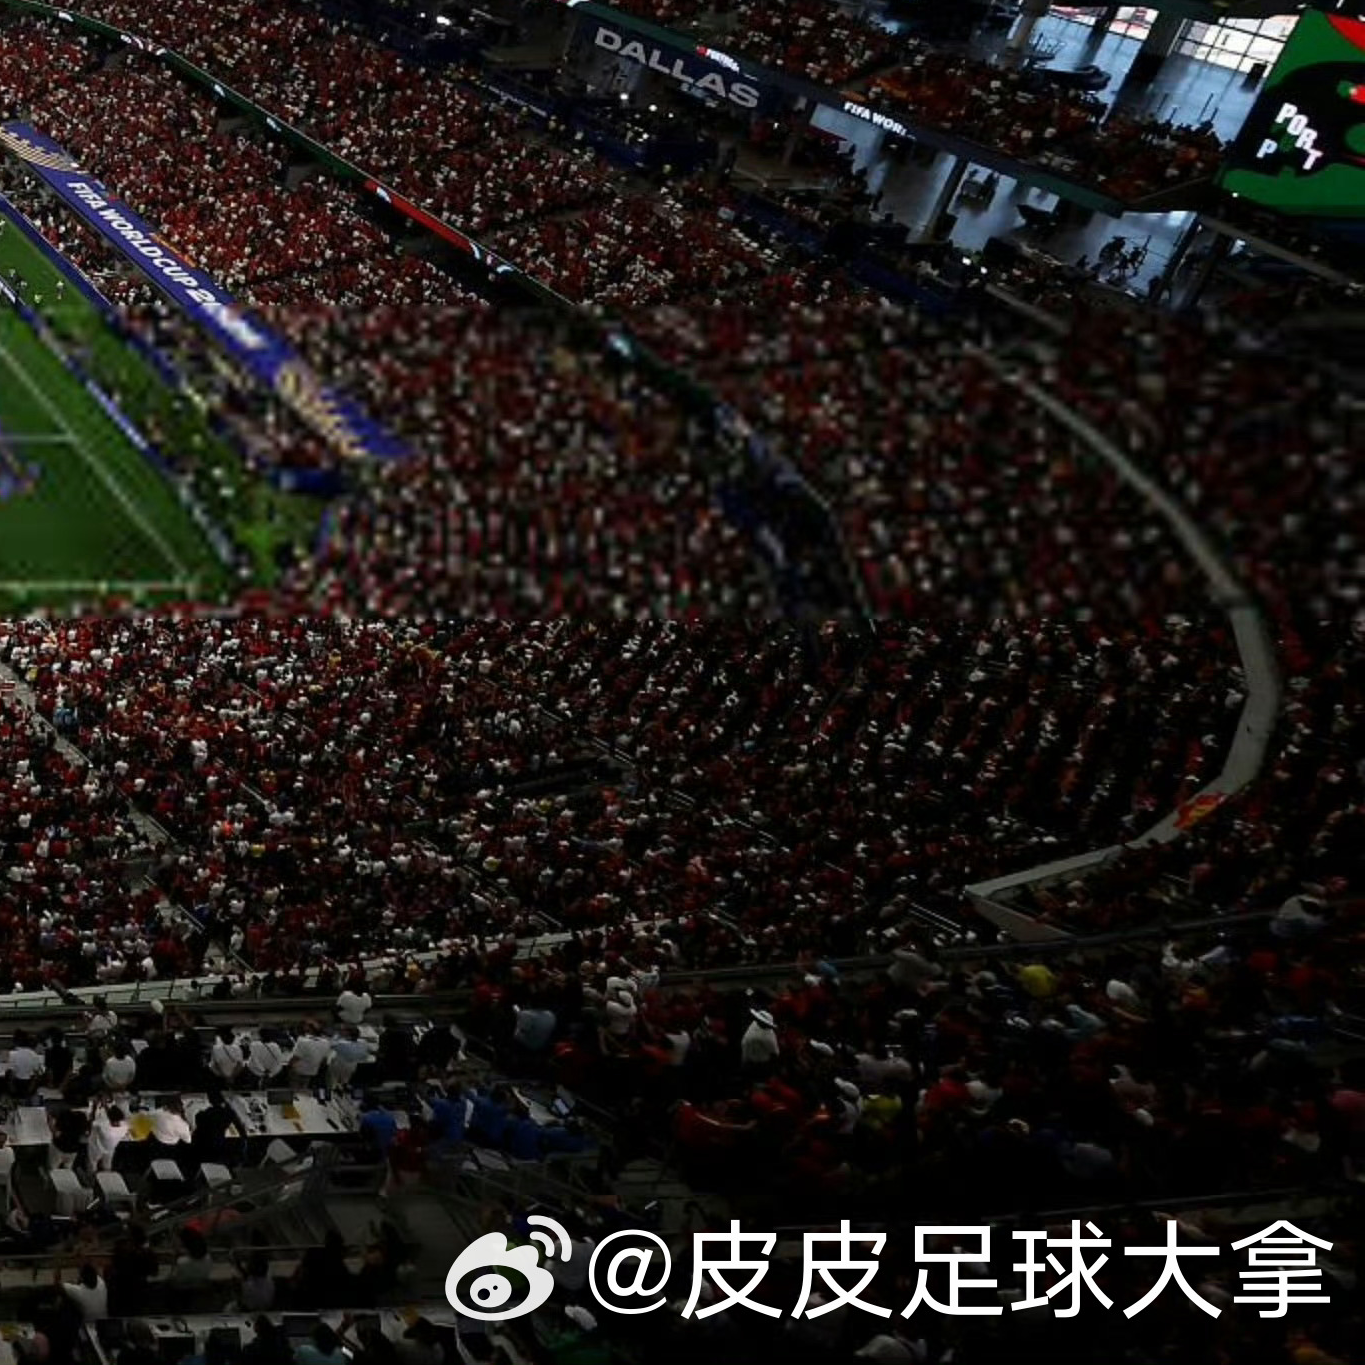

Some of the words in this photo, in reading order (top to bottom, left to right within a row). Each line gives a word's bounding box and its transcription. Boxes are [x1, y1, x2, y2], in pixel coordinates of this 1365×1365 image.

[594, 26, 761, 109] DALLAS
[843, 100, 871, 121] FIFA
[67, 181, 108, 210] FIFA
[98, 208, 164, 258] WORLD
[152, 258, 199, 288] CUP
